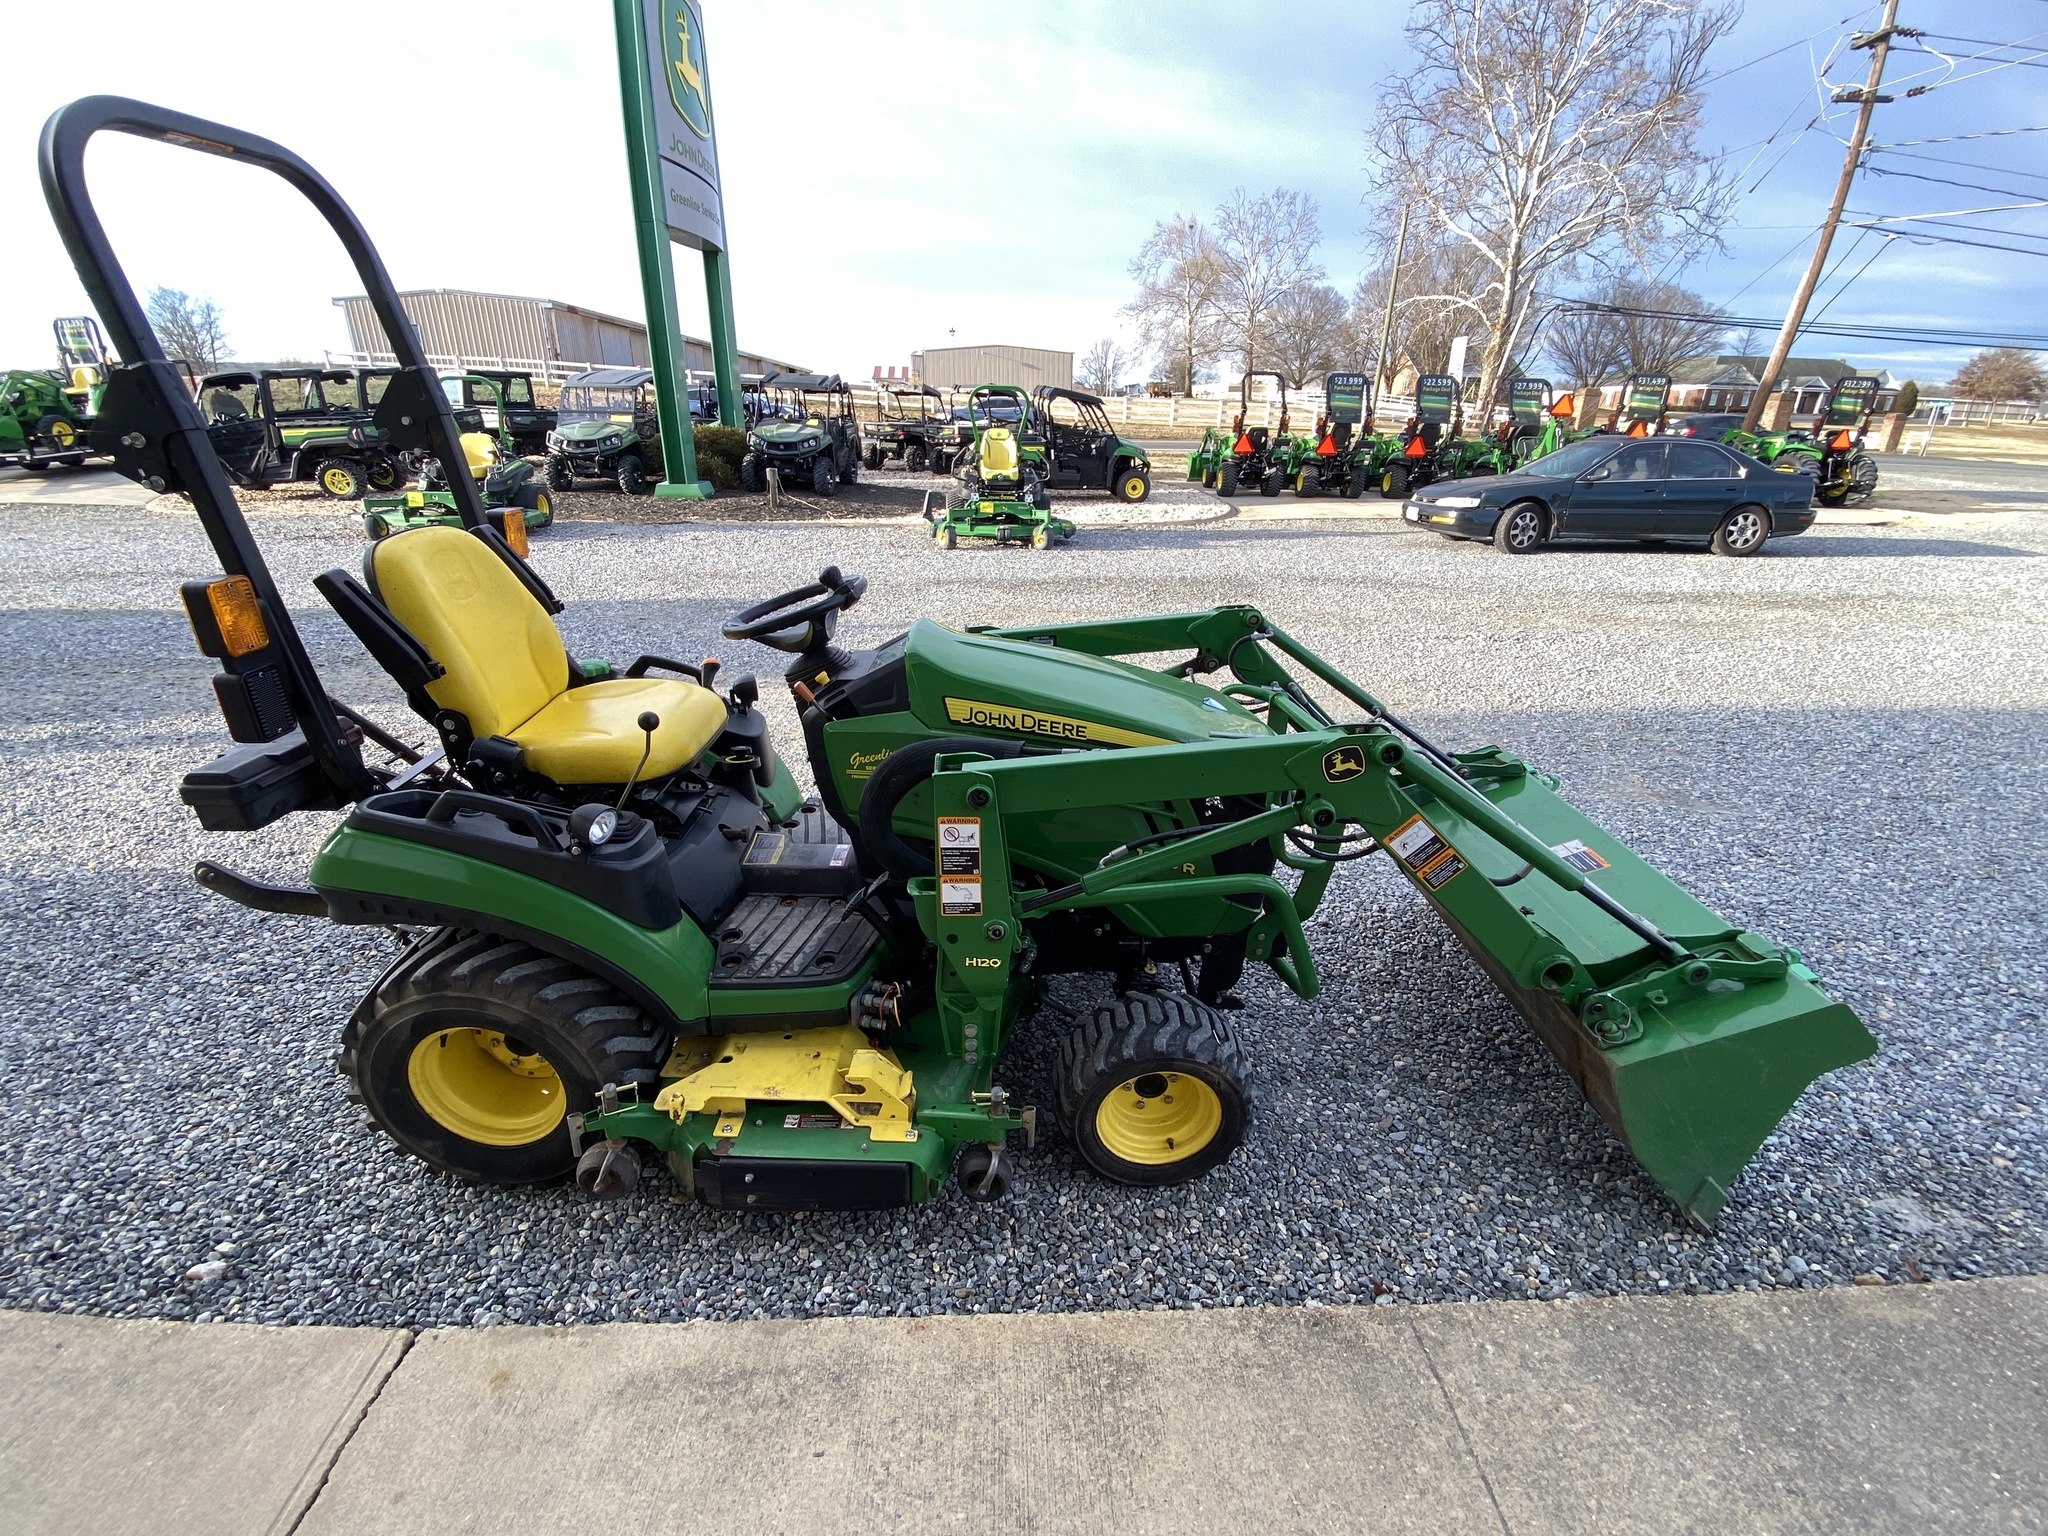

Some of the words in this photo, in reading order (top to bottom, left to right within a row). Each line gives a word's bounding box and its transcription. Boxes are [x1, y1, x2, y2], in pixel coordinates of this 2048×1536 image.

[669, 133, 697, 163] JOHN
[670, 188, 701, 213] Greenline
[1334, 376, 1363, 385] $21,999
[1423, 378, 1452, 386] $22,599
[1514, 382, 1543, 390] $27,999
[1638, 376, 1666, 385] $31,499
[1843, 380, 1872, 388] $32,299
[962, 707, 1016, 728] JOHN
[1021, 713, 1088, 739] DEERE
[1394, 818, 1418, 837] WARNING
[1429, 852, 1451, 871] WARNING
[965, 957, 1001, 968] H120
